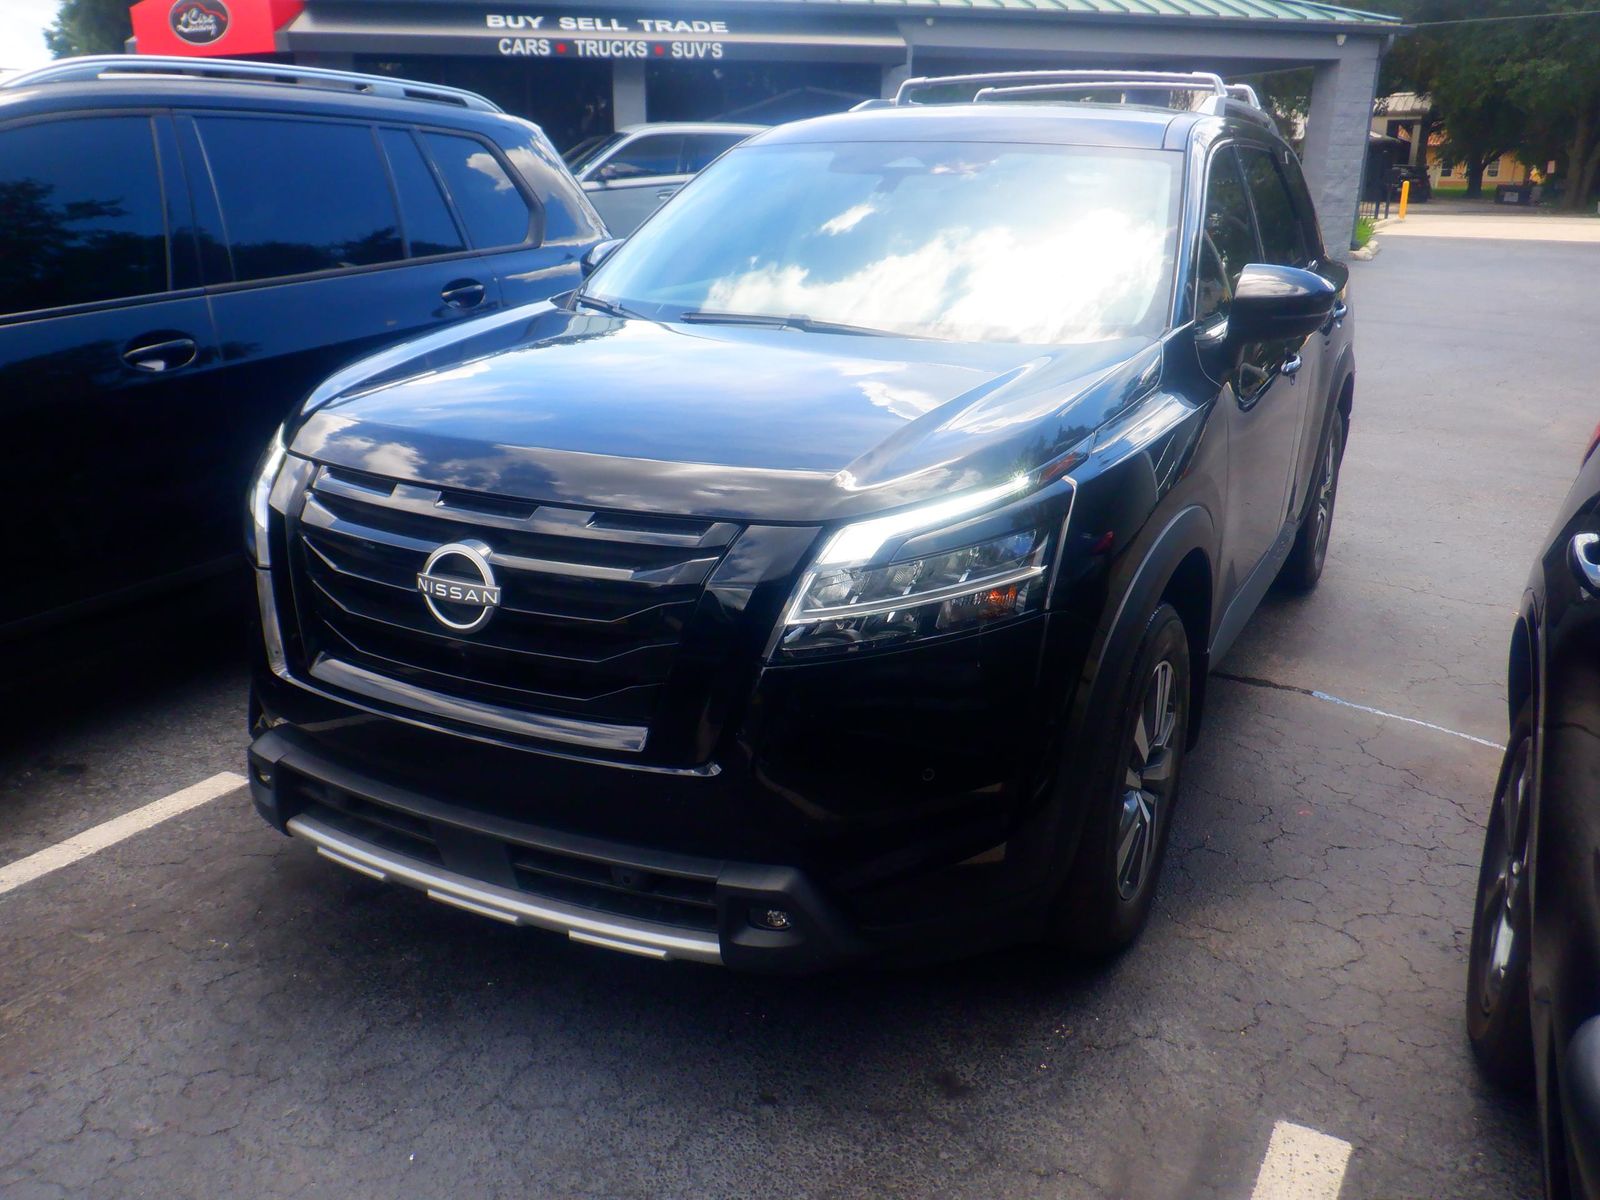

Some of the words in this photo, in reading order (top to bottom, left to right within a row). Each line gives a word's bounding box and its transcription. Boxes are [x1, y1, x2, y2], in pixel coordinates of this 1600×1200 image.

[486, 14, 544, 29] BUY
[559, 17, 628, 32] SELL
[637, 19, 728, 33] TRADE
[498, 38, 550, 56] CARS
[574, 39, 648, 58] TRUCKS
[671, 41, 723, 58] SUV'S
[417, 577, 498, 604] NISSAN
